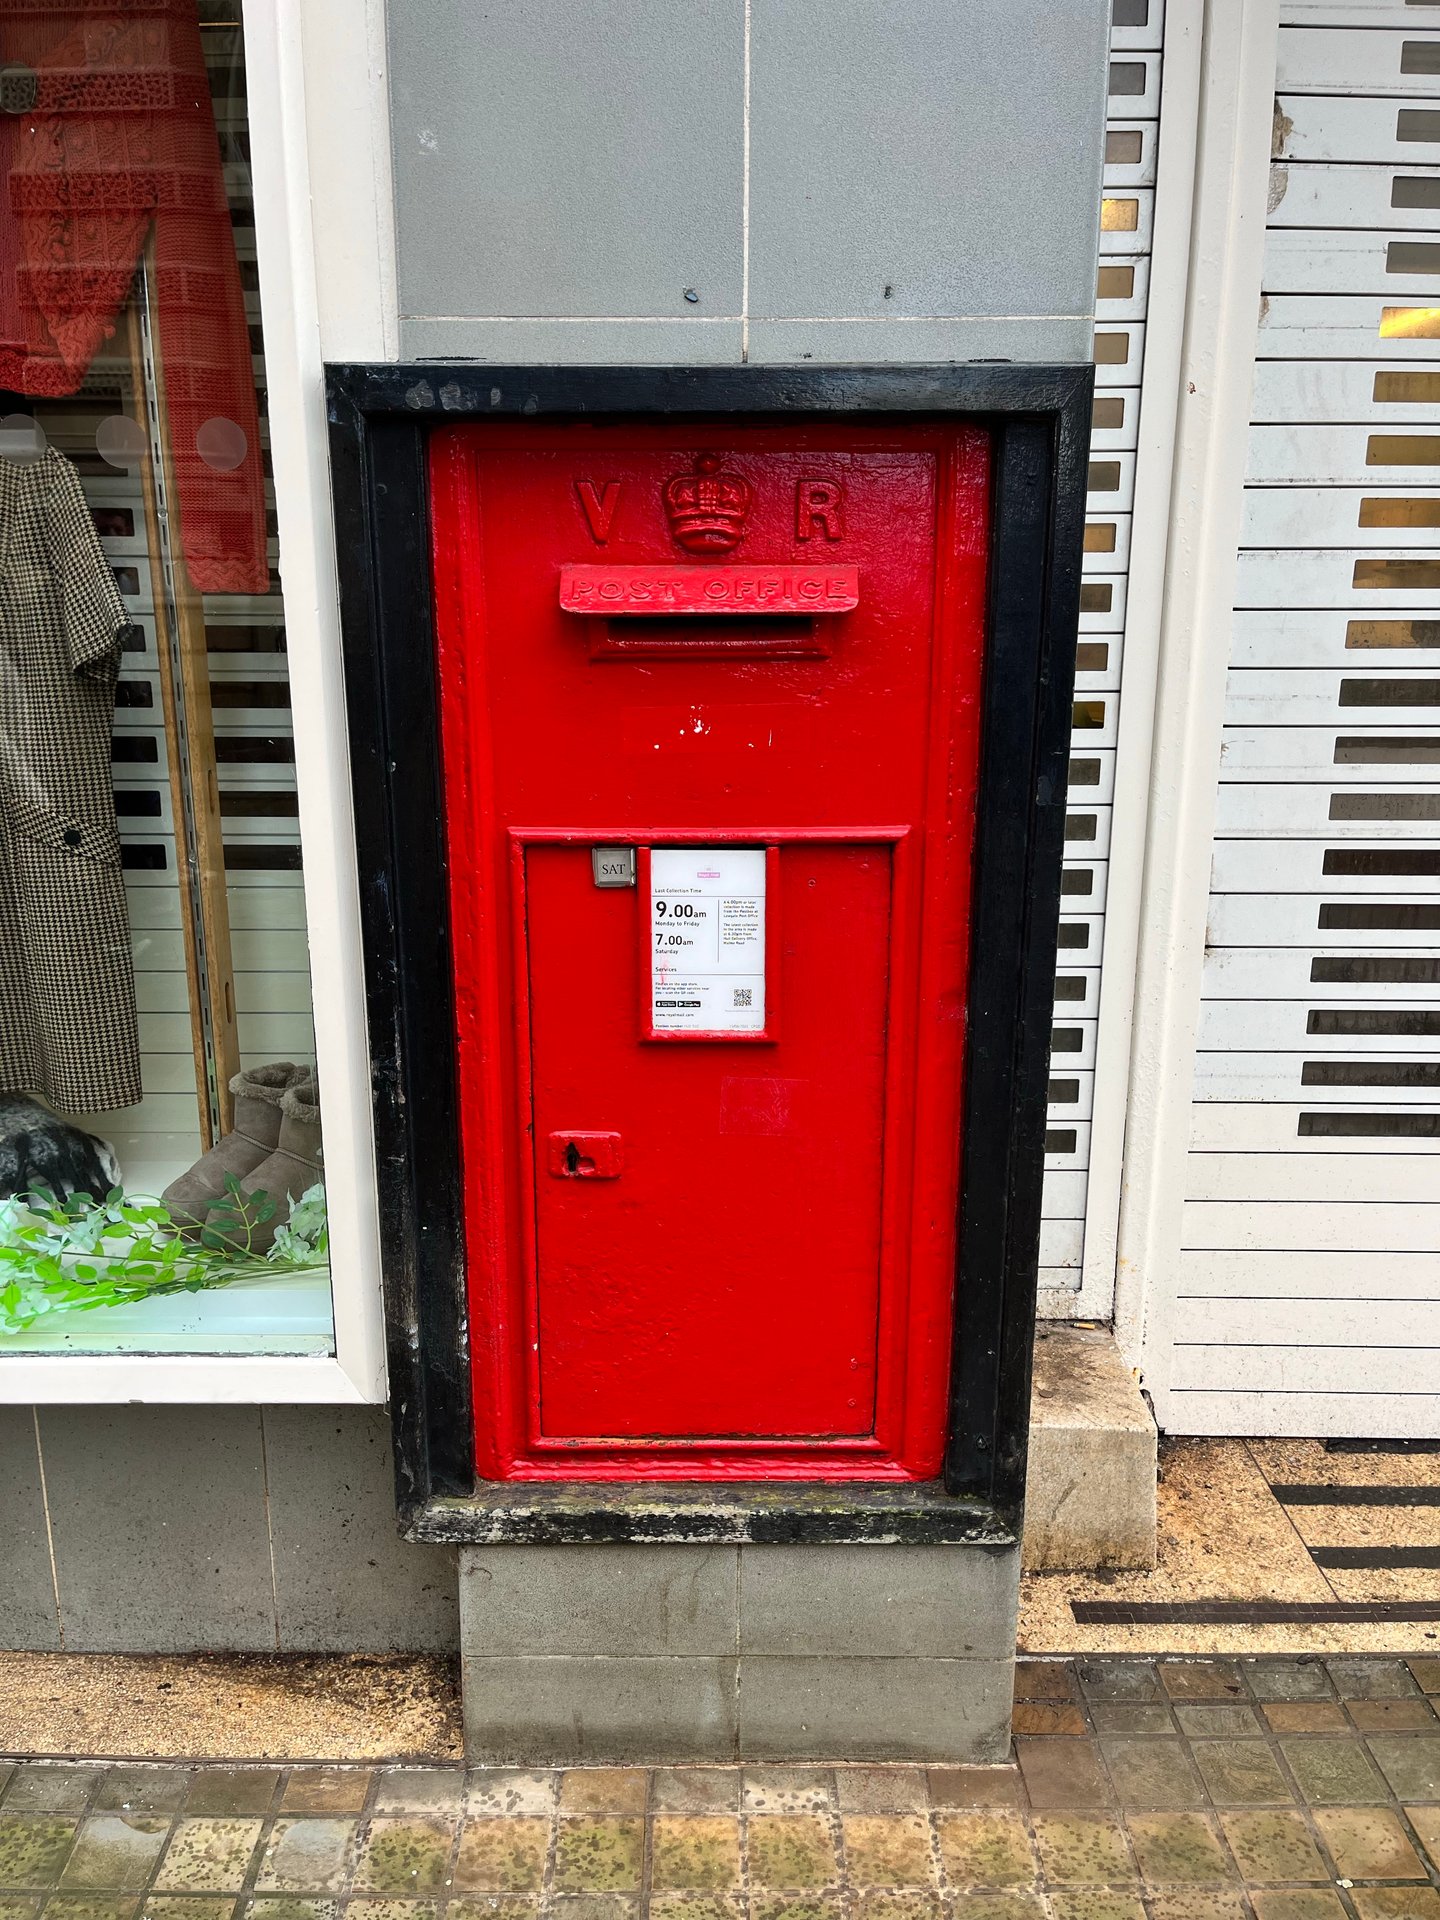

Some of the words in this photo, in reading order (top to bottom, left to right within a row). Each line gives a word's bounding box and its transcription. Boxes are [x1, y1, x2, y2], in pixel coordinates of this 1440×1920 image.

[575, 478, 621, 544] V
[795, 477, 843, 542] R
[571, 578, 683, 600] POST
[703, 577, 848, 600] OFFICE
[602, 864, 625, 874] SAT
[656, 901, 706, 918] 9.00am
[656, 934, 693, 945] 7.00am
